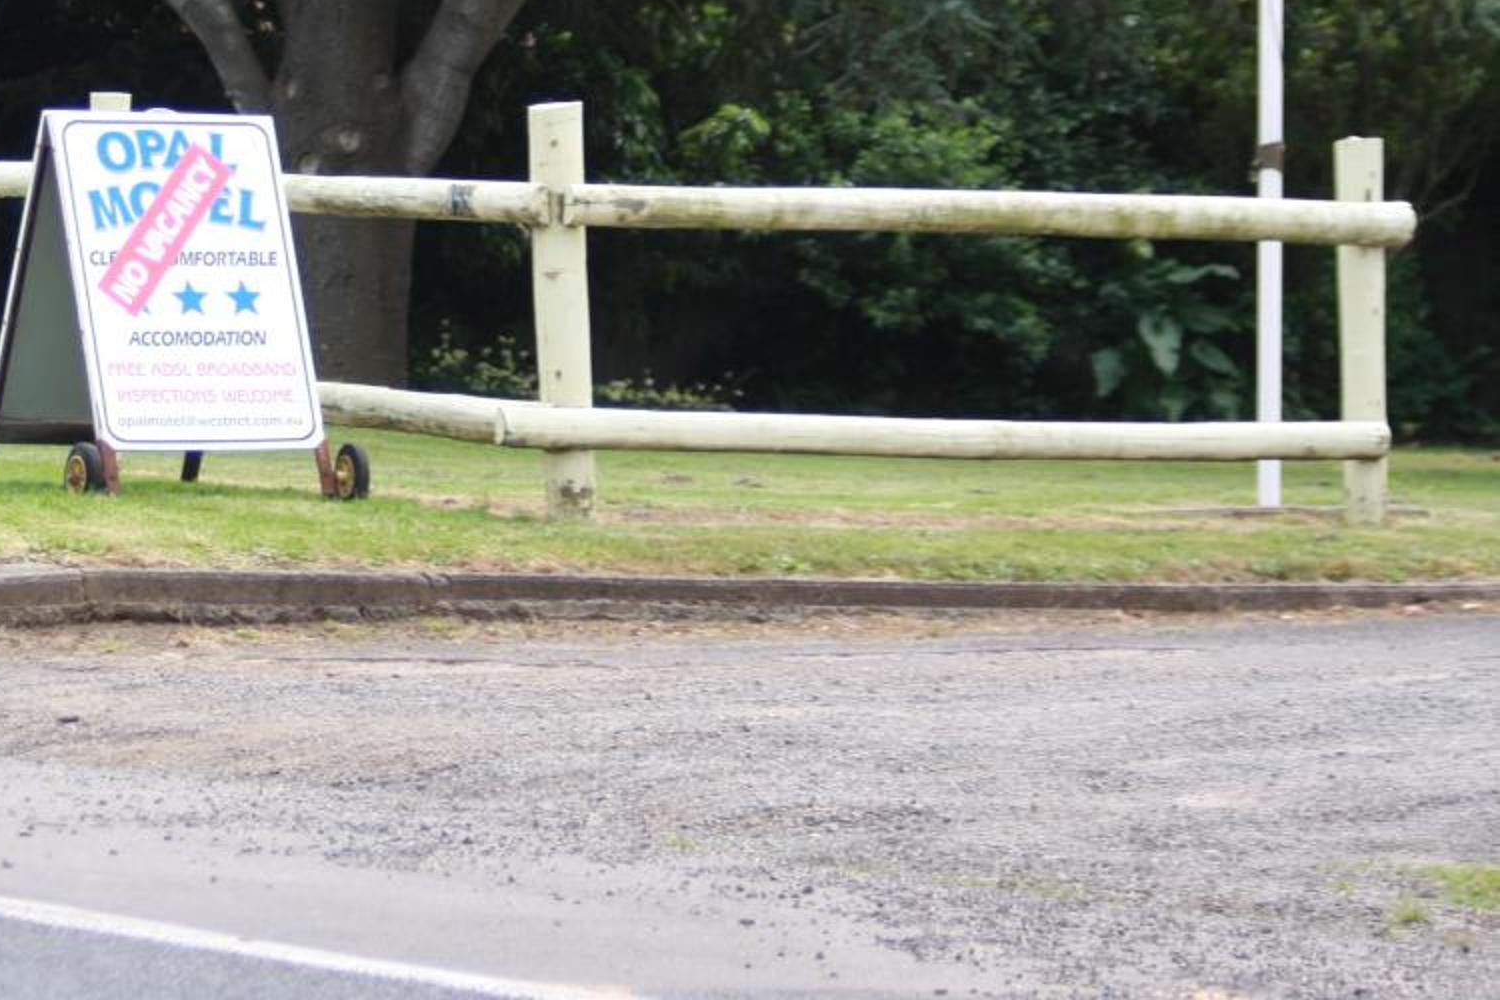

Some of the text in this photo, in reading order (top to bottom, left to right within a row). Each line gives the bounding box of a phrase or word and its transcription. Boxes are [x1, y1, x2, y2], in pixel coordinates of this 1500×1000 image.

[88, 181, 267, 232] MOEL
[111, 156, 218, 305] NO VACANCY
[128, 330, 267, 347] ACCOMODATION
[108, 361, 146, 377] FREE
[117, 388, 293, 404] INSPECTIONS WELCOME
